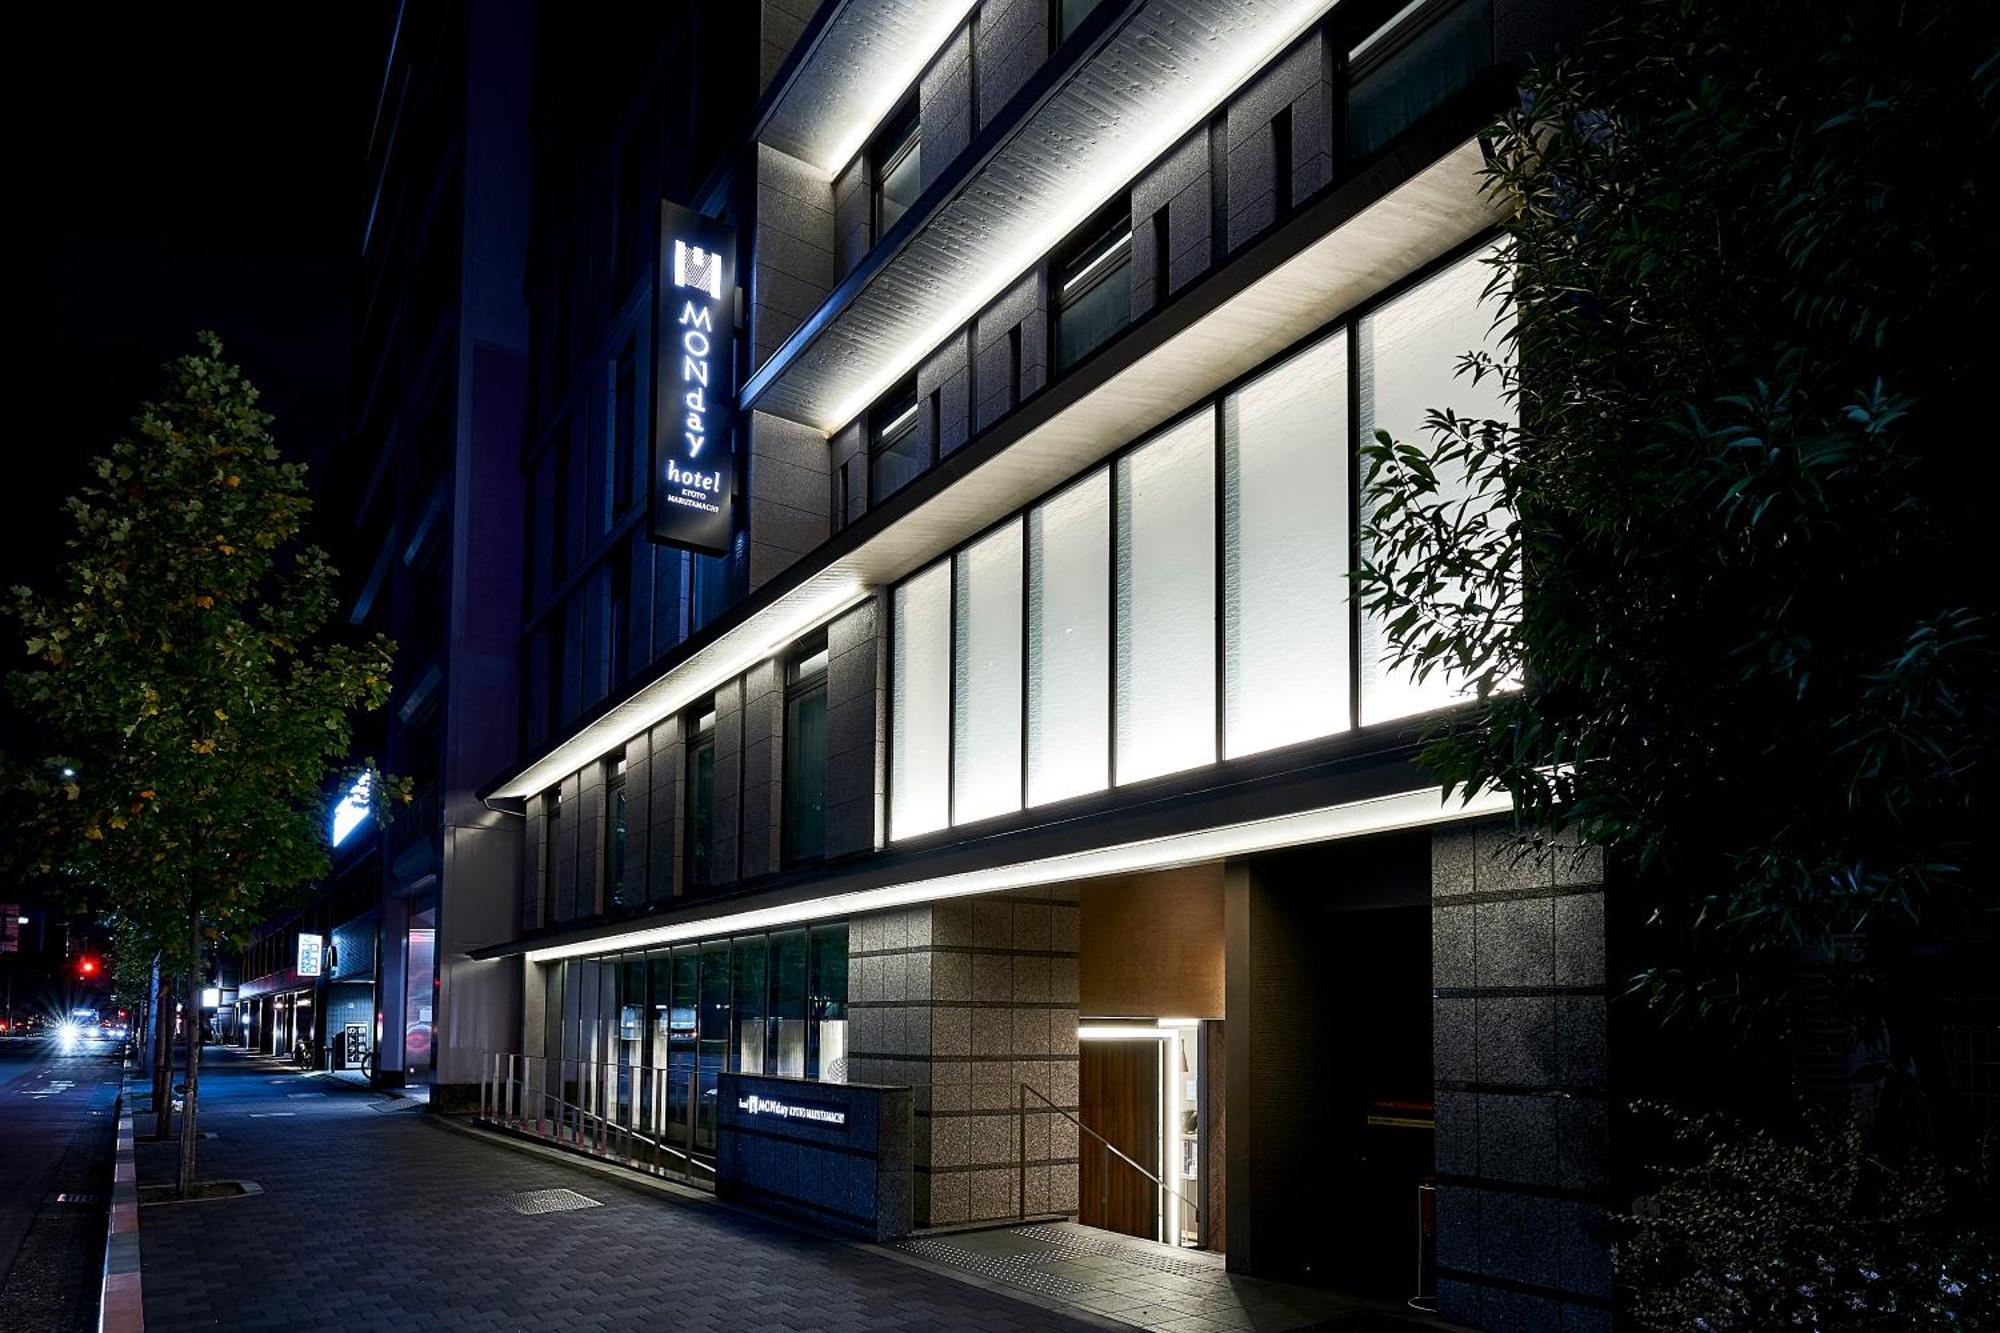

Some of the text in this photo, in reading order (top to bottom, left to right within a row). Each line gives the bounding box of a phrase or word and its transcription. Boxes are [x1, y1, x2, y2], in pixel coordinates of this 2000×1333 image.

[679, 300, 712, 457] MONday
[668, 459, 720, 492] hotel
[682, 488, 706, 500] KYOTO
